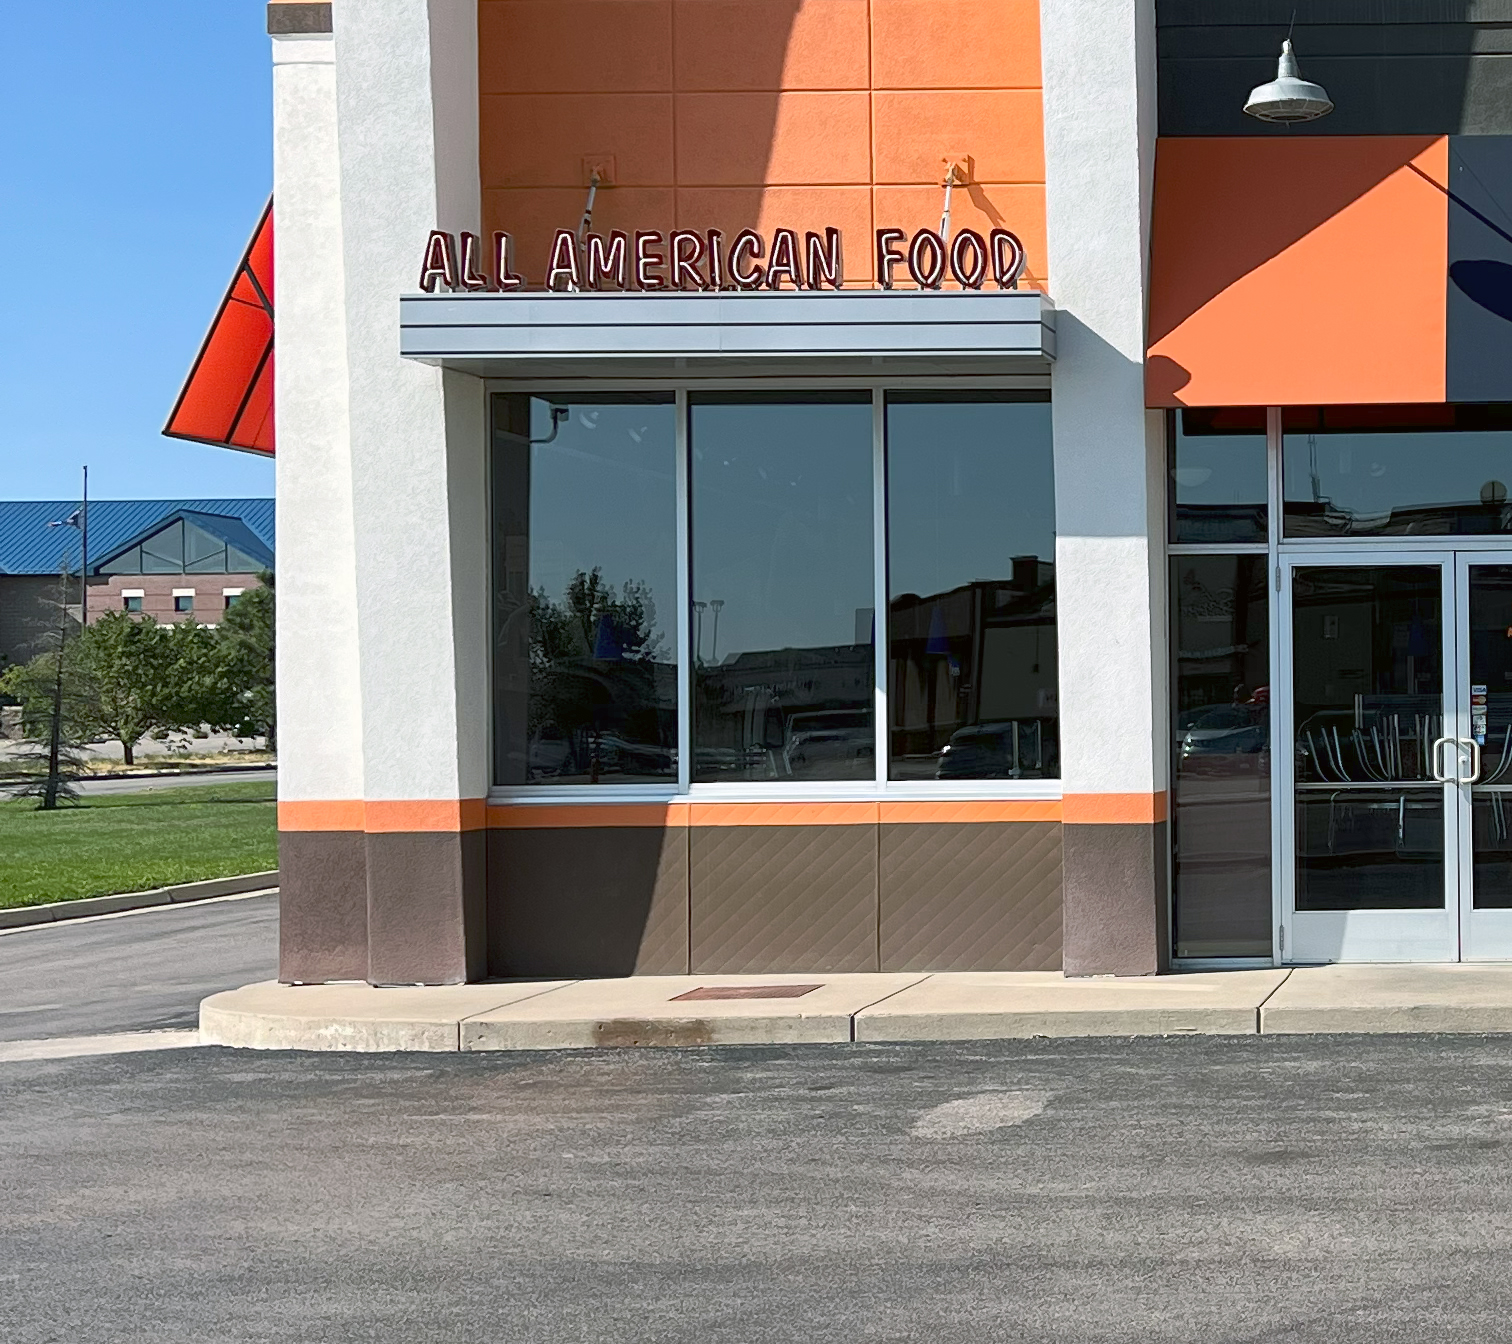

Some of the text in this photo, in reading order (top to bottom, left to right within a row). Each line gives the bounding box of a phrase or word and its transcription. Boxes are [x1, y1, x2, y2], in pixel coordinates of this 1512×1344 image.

[419, 227, 1026, 292] ALL AMERICAN FOOD
